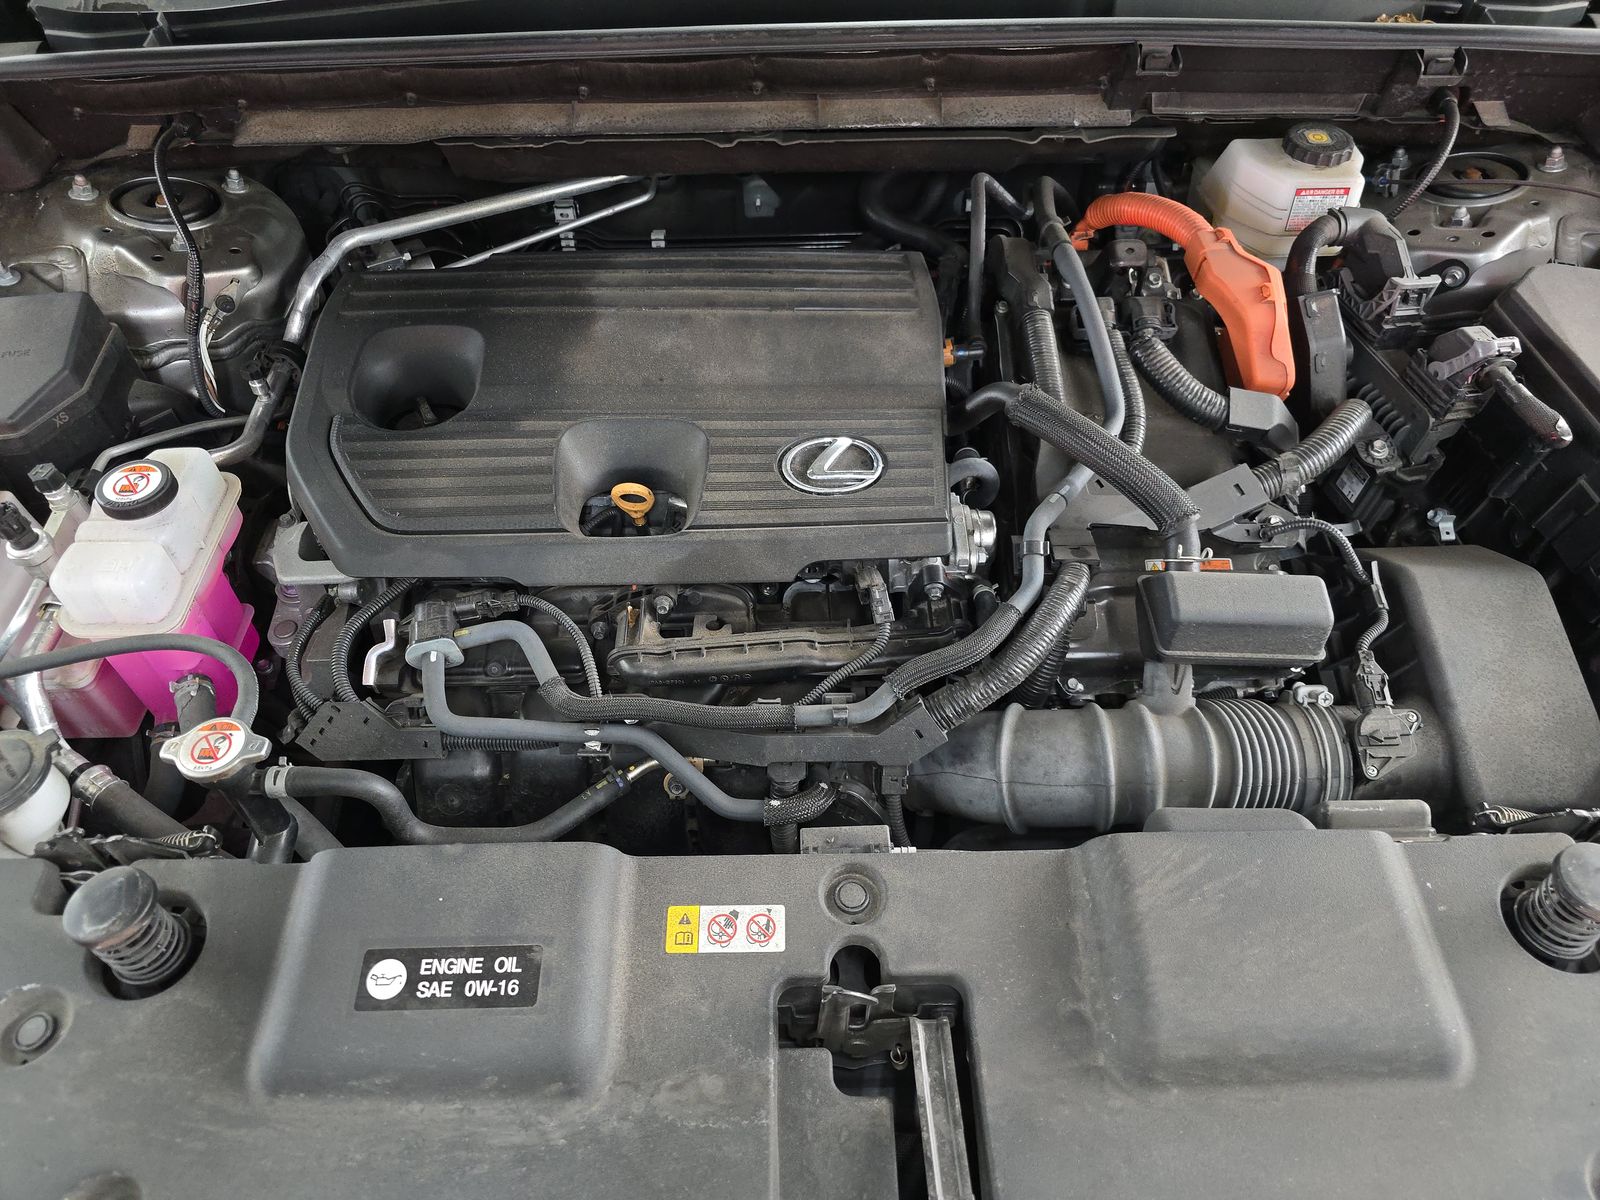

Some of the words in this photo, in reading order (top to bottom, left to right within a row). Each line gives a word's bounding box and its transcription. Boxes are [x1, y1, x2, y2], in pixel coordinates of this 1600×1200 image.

[420, 957, 484, 975] ENGINE
[494, 956, 522, 973] OIL
[416, 981, 453, 998] SAE
[464, 979, 519, 997] 0W-16
